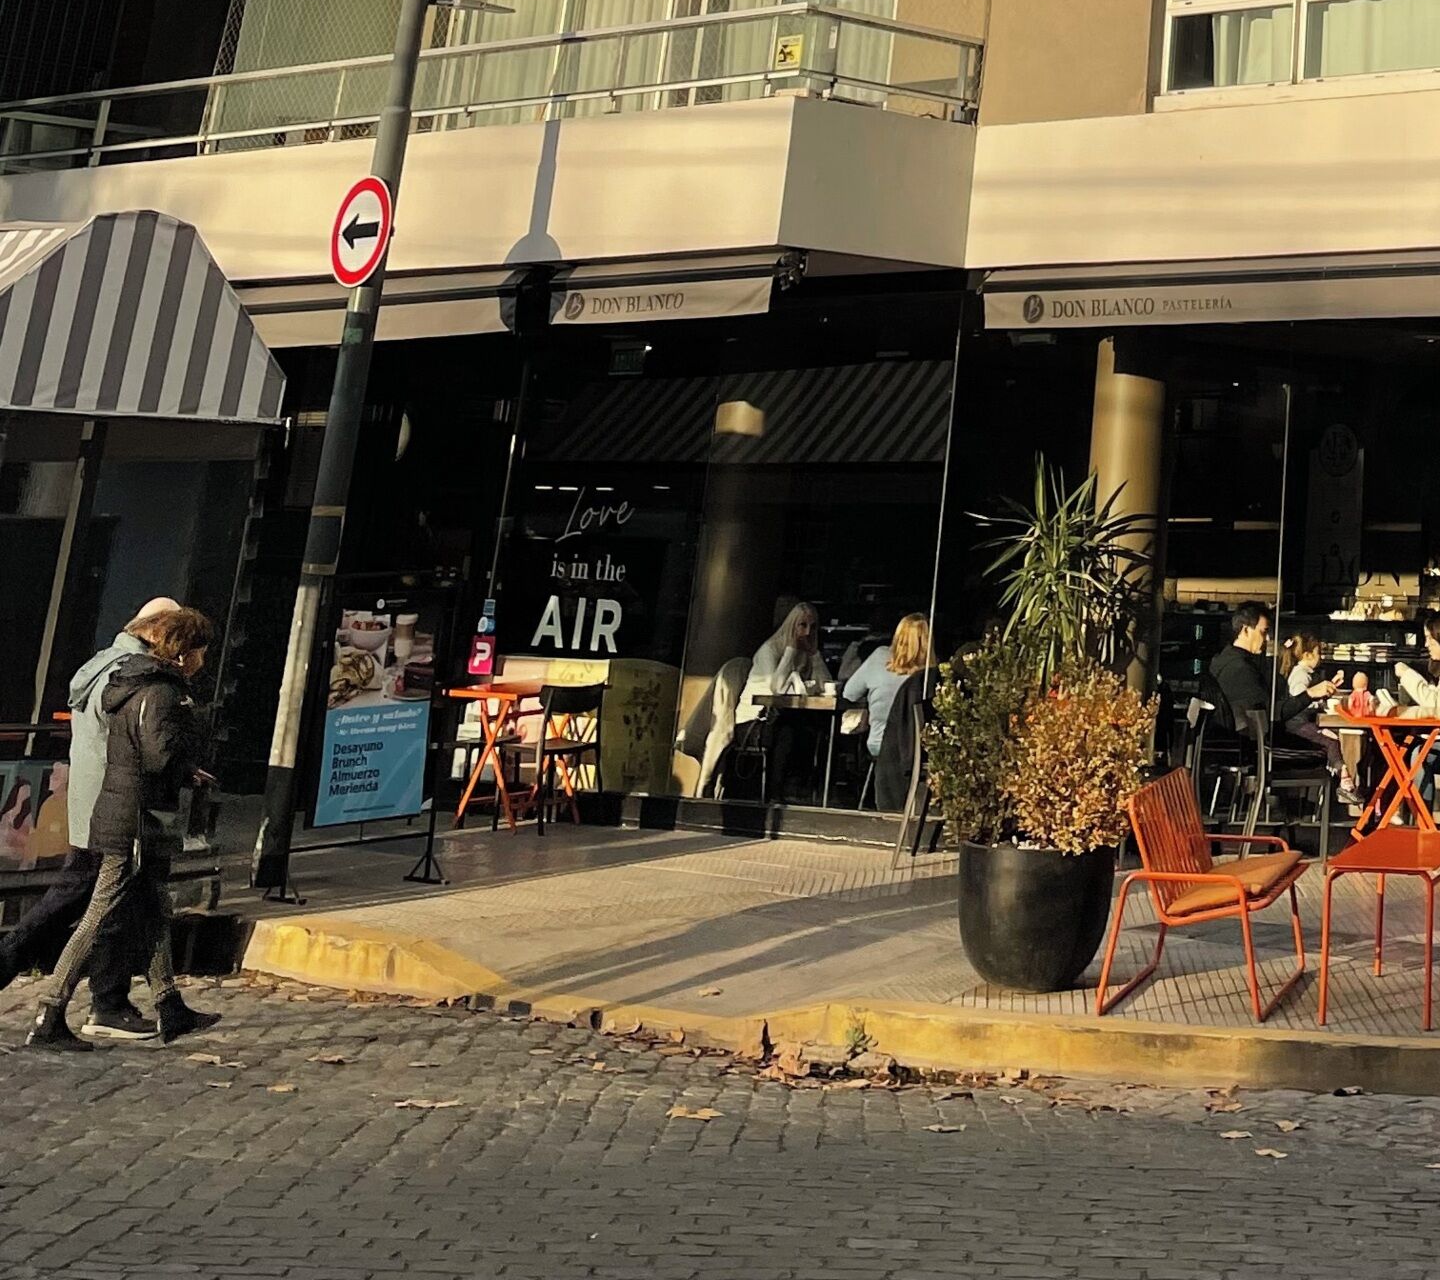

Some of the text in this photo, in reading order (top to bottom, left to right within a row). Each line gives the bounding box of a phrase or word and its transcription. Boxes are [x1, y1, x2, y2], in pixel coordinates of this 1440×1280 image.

[591, 297, 621, 315] DON
[625, 292, 684, 313] BLANCO
[1051, 299, 1086, 319] DON
[1091, 297, 1155, 317] BLANCO
[1162, 295, 1233, 311] PASTELERÍA
[554, 486, 636, 543] Love
[550, 552, 627, 582] is in the
[530, 594, 623, 654] AIR
[333, 741, 384, 756] Desayuno
[332, 755, 368, 769] Brunch
[330, 769, 380, 783] Almuerzo
[329, 781, 378, 797] Merienda
